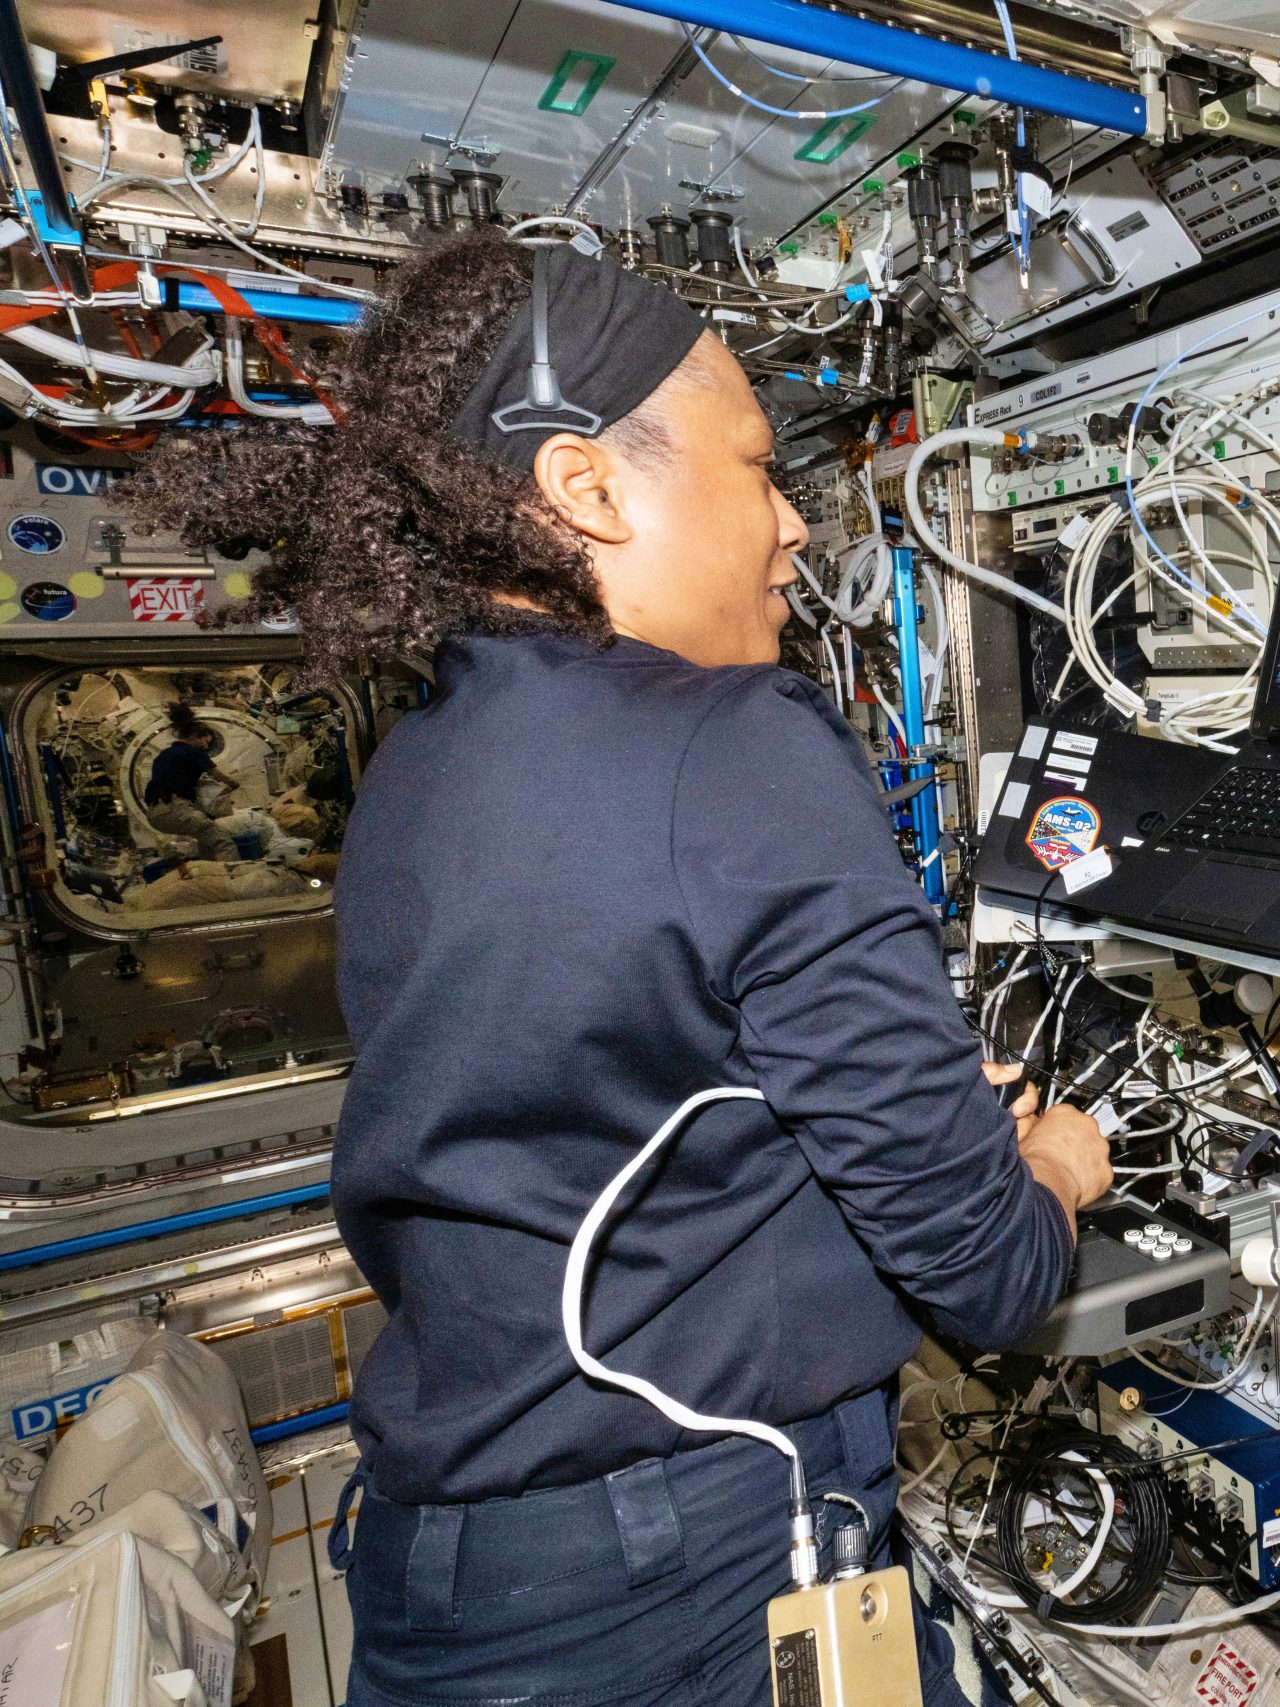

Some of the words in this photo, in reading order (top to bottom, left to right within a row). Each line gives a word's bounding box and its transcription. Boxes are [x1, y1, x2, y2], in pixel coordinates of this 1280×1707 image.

[1019, 394, 1024, 408] 9
[974, 407, 999, 424] EXPRESS
[1000, 404, 1012, 416] Rack
[23, 517, 50, 525] volare
[140, 587, 193, 611] EXIT
[1043, 813, 1091, 832] AMS-02
[872, 1633, 882, 1642] PTT
[1212, 1668, 1227, 1685] FIRE
[1226, 1681, 1243, 1699] PORT
